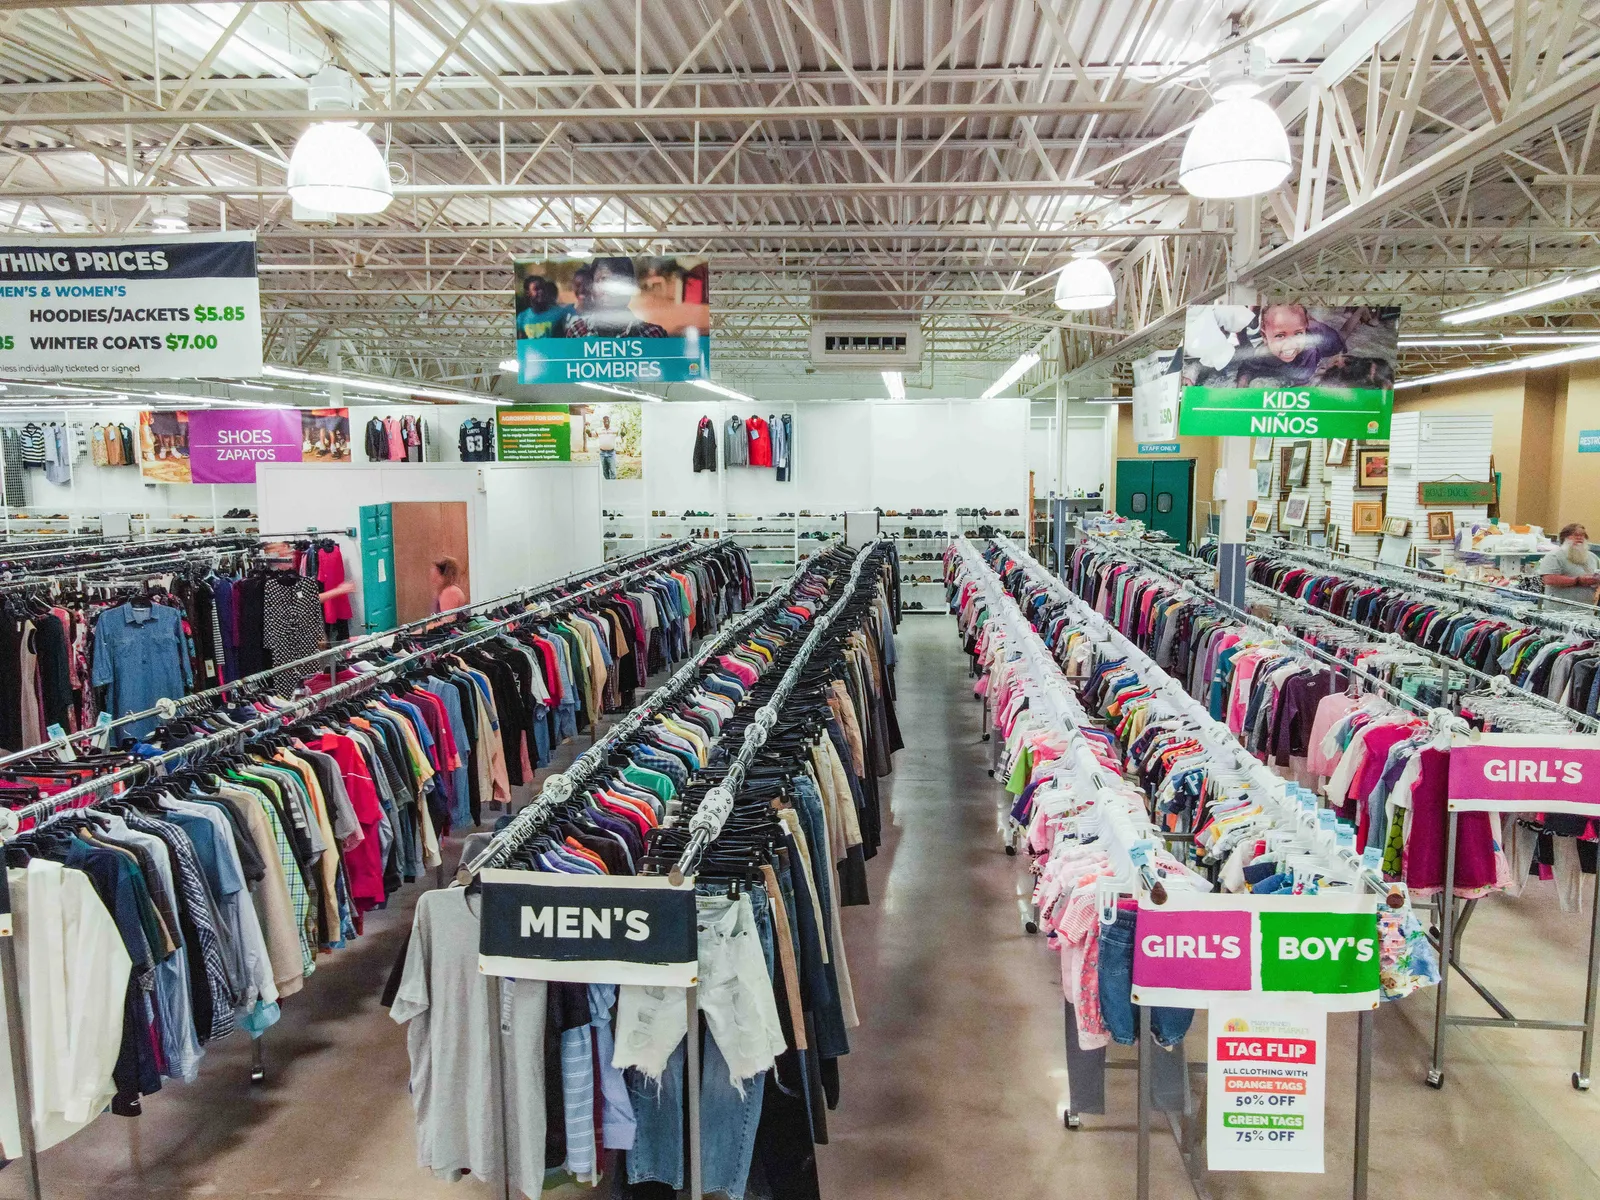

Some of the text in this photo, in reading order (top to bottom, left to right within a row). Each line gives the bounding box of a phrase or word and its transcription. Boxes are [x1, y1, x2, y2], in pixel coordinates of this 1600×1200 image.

[75, 251, 169, 272] PRICES
[41, 286, 51, 297] &
[55, 285, 127, 297] WOMEN'S
[30, 304, 245, 323] HOODIES/JACKETS $5.85
[30, 336, 98, 350] WINTER
[103, 336, 162, 350] COATS
[165, 334, 218, 351] $7.00
[584, 341, 642, 357] MEN'S
[18, 364, 64, 374] individually
[65, 364, 99, 373] ticketed
[111, 364, 140, 374] signed
[566, 361, 661, 379] HOMBRES
[1262, 391, 1310, 409] KIDS
[1250, 412, 1319, 434] NIÑOS
[218, 430, 272, 444] SHOES
[466, 435, 483, 452] 63
[217, 448, 276, 461] ZAPATOS
[1483, 759, 1583, 784] GIRL'S
[520, 906, 650, 941] MEN'S
[1141, 935, 1241, 959] GIRL'S
[1278, 936, 1374, 962] BOY'S
[1226, 1042, 1307, 1058] TAG FLIP
[1240, 1068, 1283, 1076] CLOTHING
[1228, 1080, 1303, 1091] ORANGE TAGS
[1236, 1094, 1296, 1106] 50% OFF
[1228, 1115, 1302, 1126] GREEN TAGS
[1236, 1130, 1296, 1142] 75% OFF
